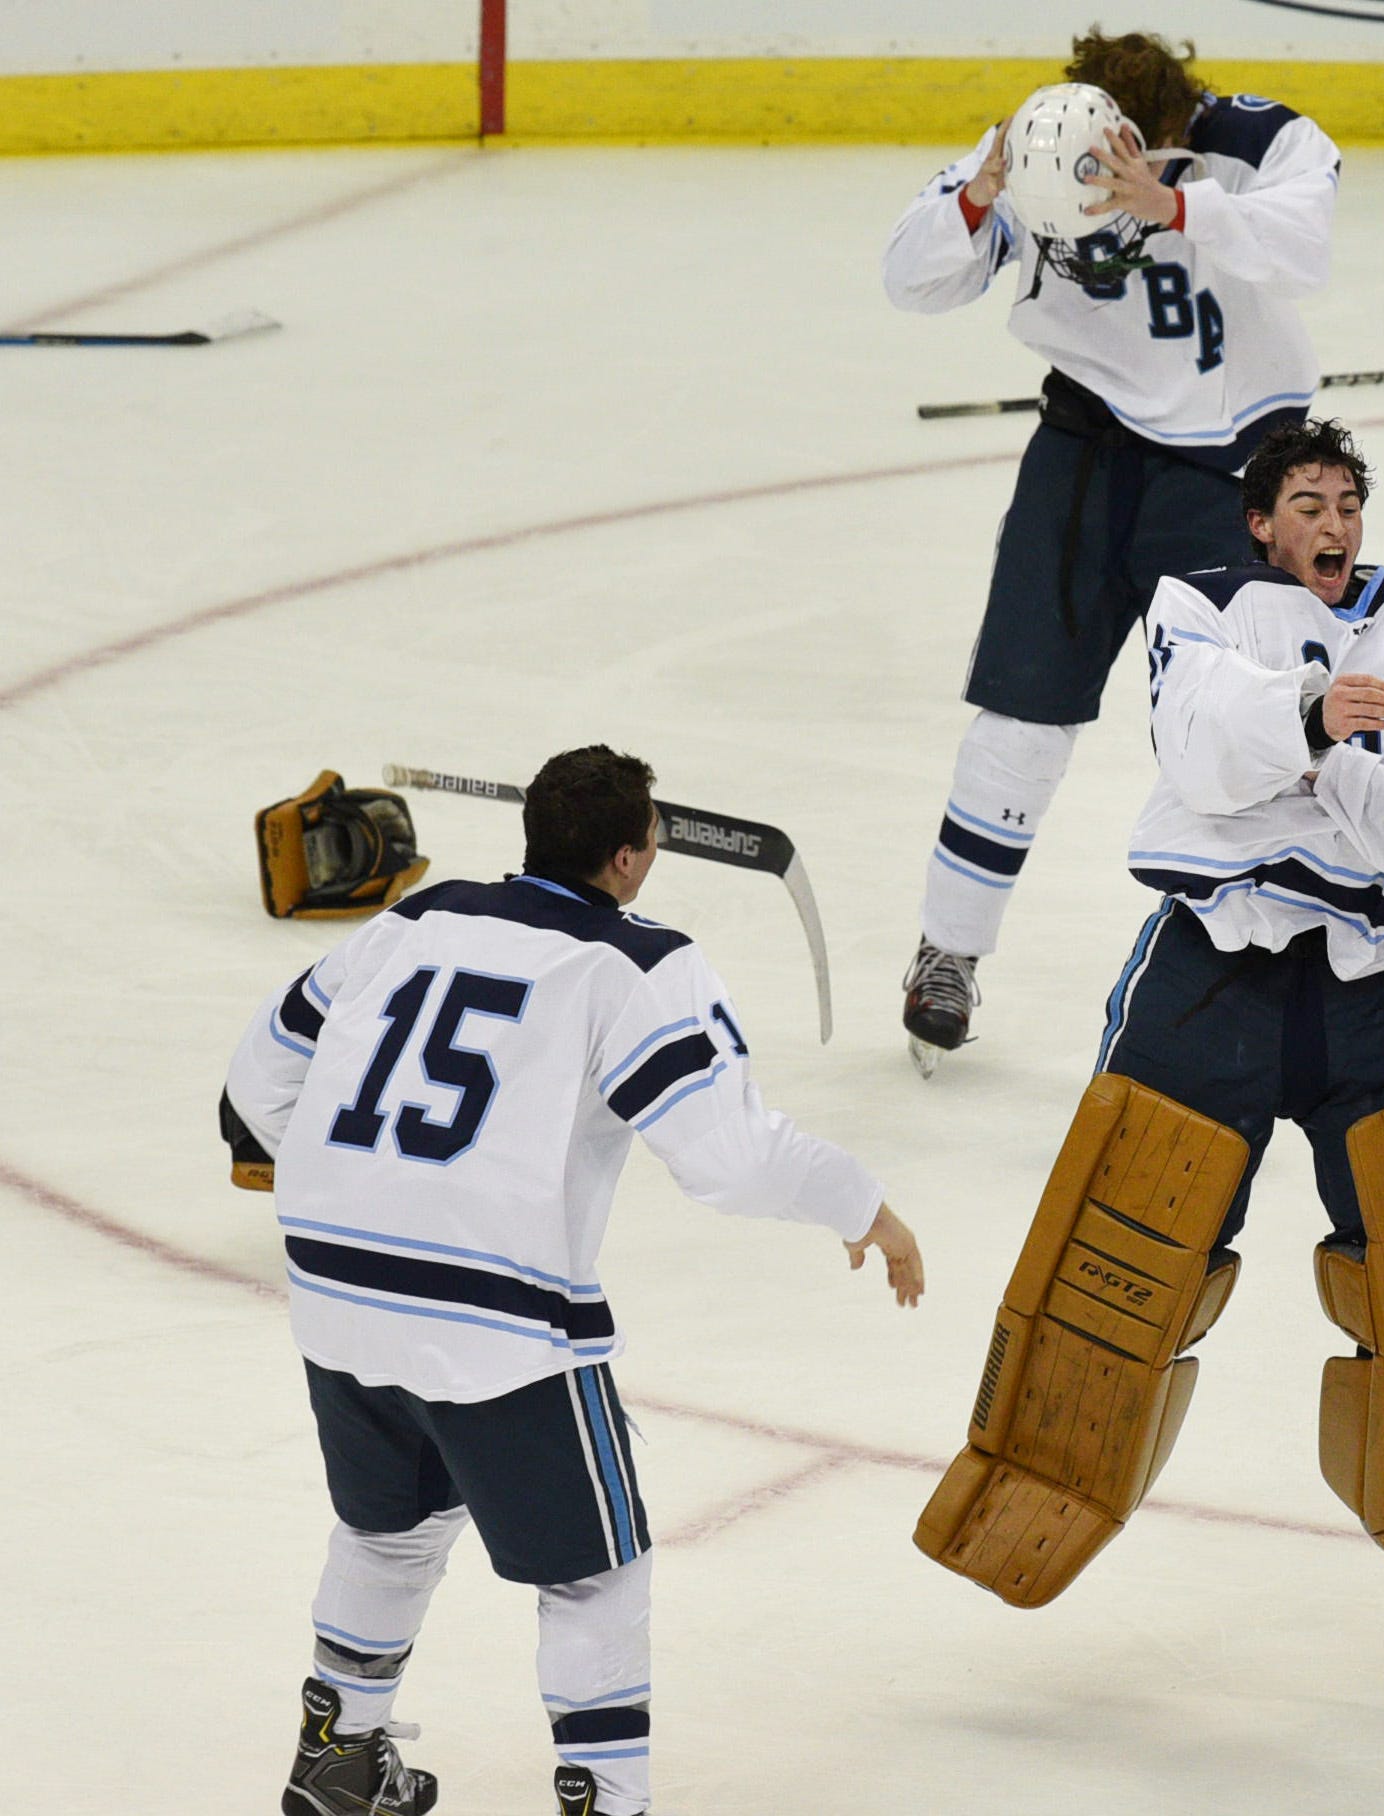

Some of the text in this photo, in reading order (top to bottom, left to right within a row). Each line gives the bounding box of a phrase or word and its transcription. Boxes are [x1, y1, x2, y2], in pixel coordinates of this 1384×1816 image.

[325, 964, 536, 1167] 15
[972, 1322, 1012, 1433] WARRIOR
[304, 1689, 333, 1707] CCM
[558, 1779, 587, 1788] CCM
